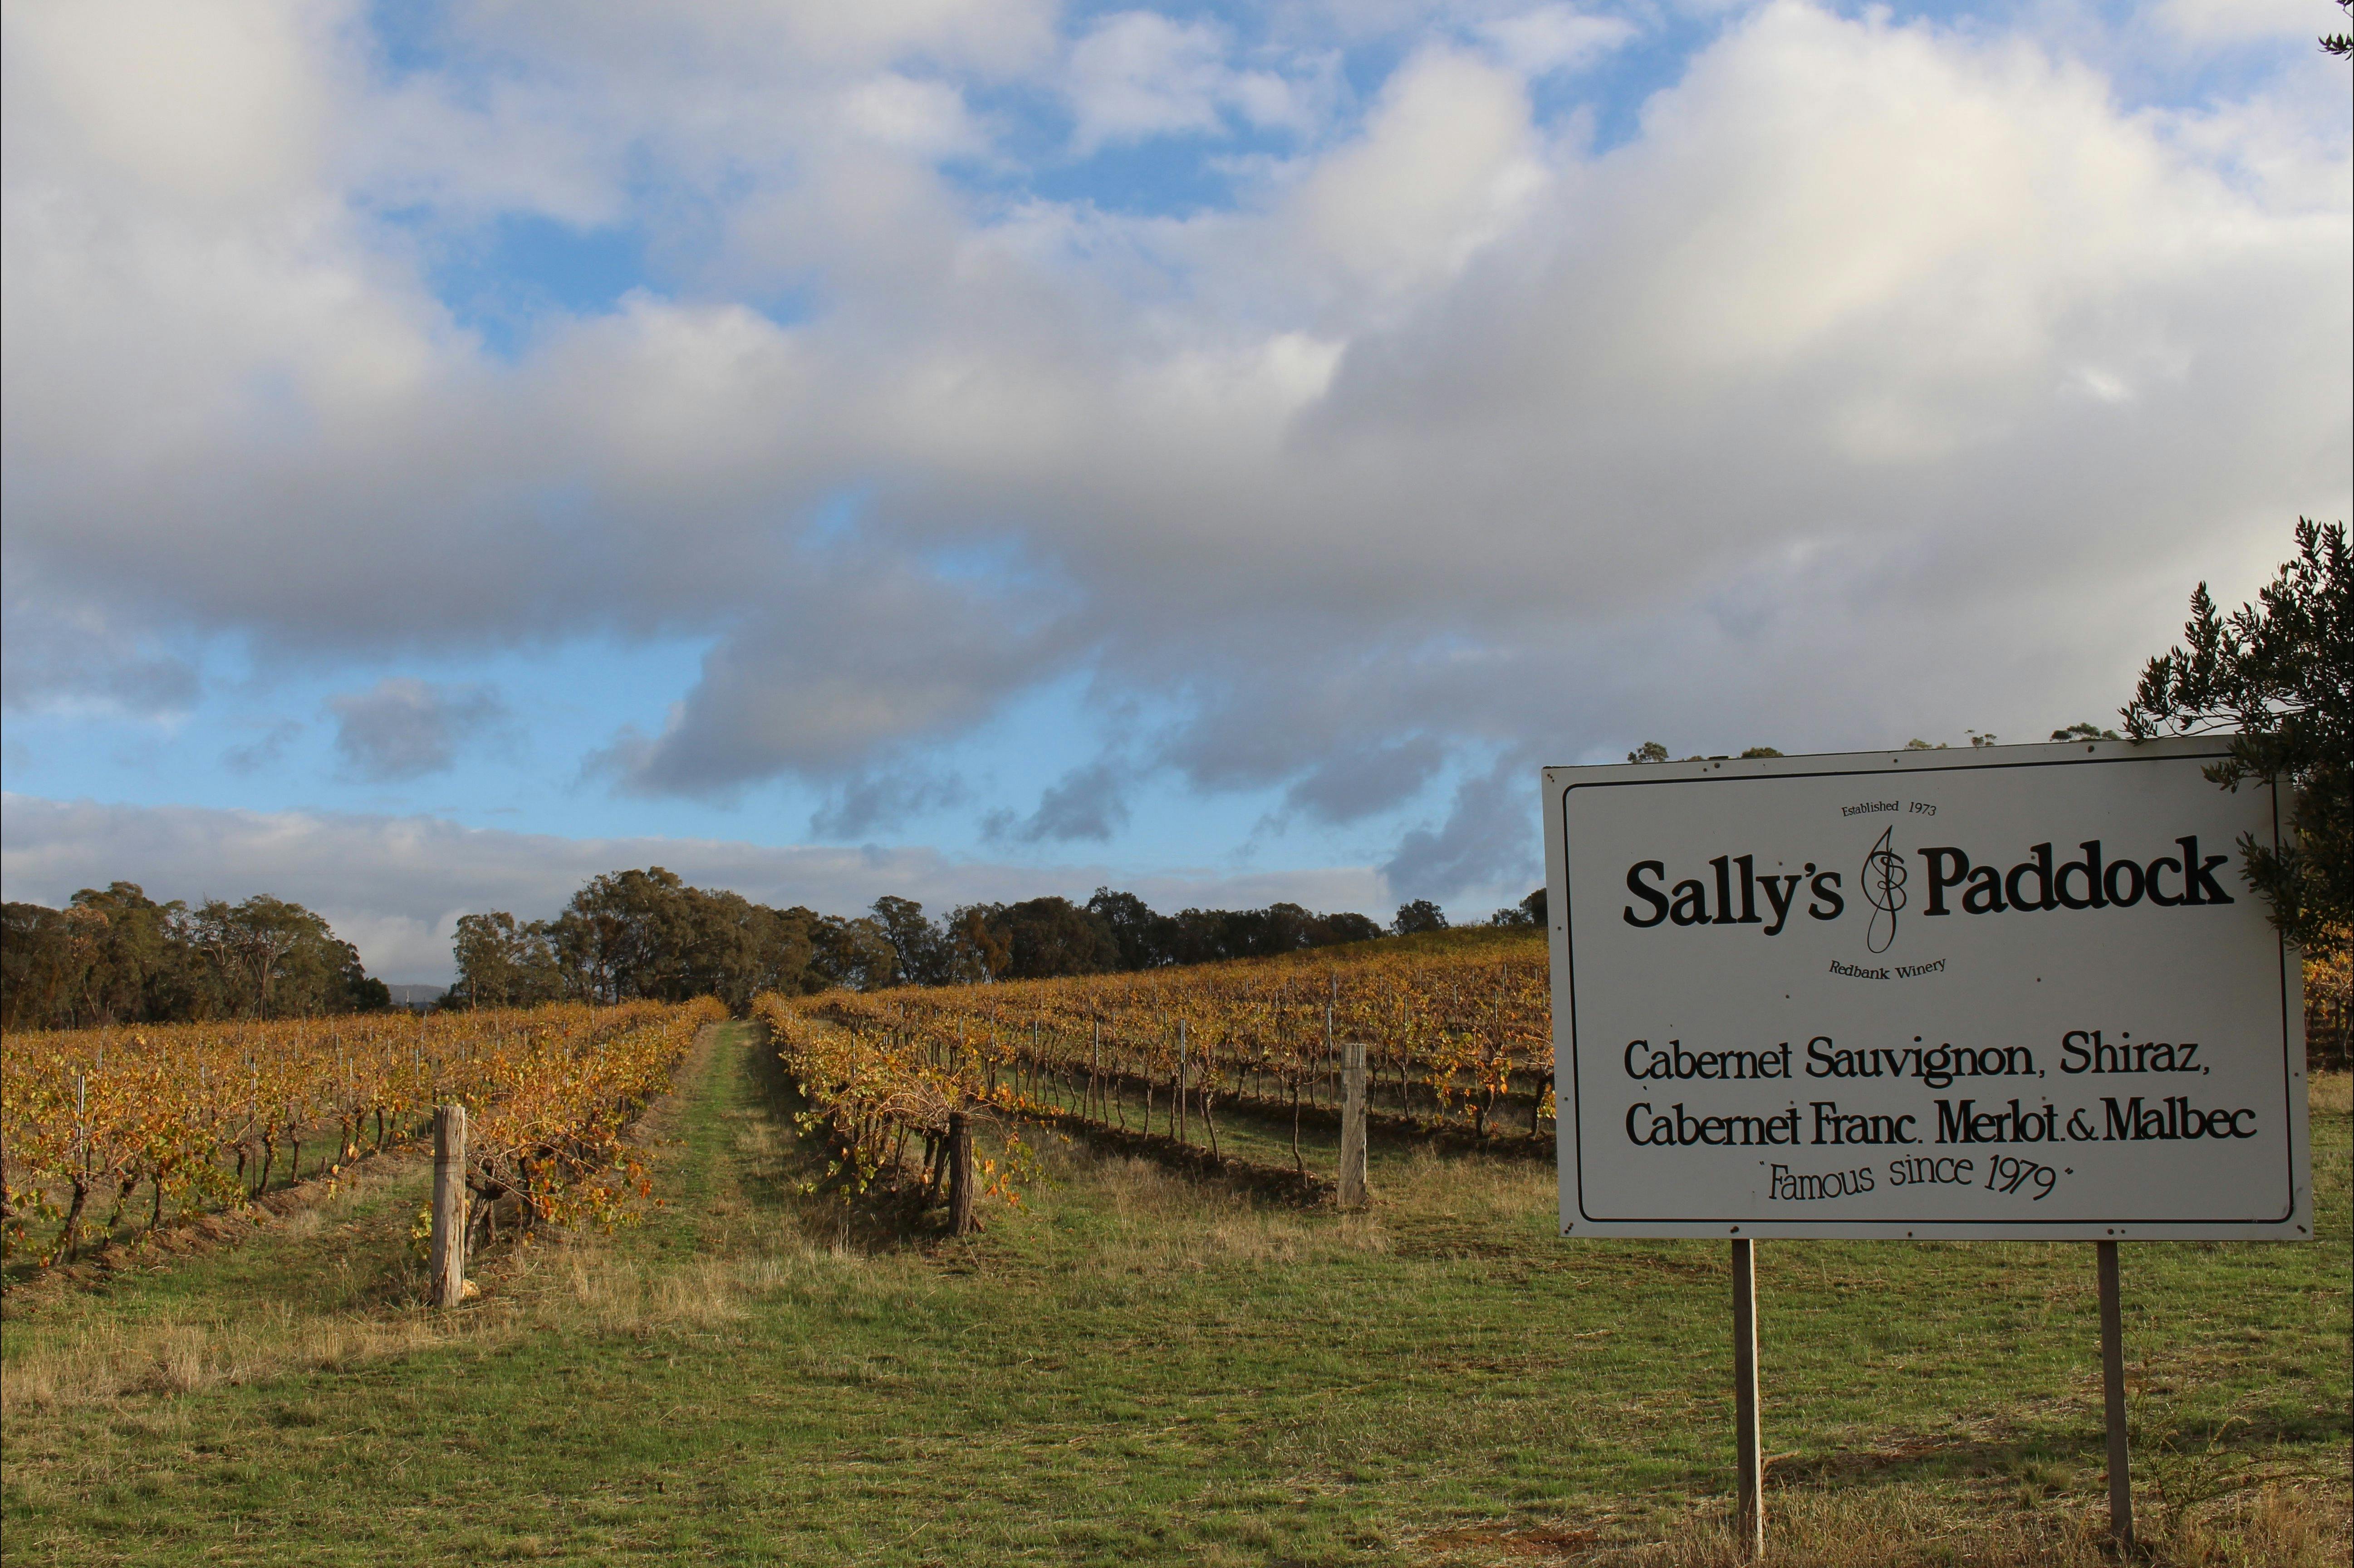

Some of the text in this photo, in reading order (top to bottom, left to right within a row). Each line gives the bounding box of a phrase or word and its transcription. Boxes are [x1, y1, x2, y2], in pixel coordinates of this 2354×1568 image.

[1841, 800, 1937, 817] Established 1973
[1623, 854, 1844, 936] Sally's
[1917, 835, 2234, 916] Paddock
[1829, 958, 1946, 980] Redbank Winery
[1624, 1030, 2210, 1089] Cabernet Sauvignon, Shiraz,
[1625, 1102, 1802, 1146] Cabernet
[1809, 1101, 1923, 1145] Franc.
[2066, 1107, 2099, 1142] &
[2099, 1096, 2258, 1141] Malbec
[1889, 1154, 1974, 1186] since
